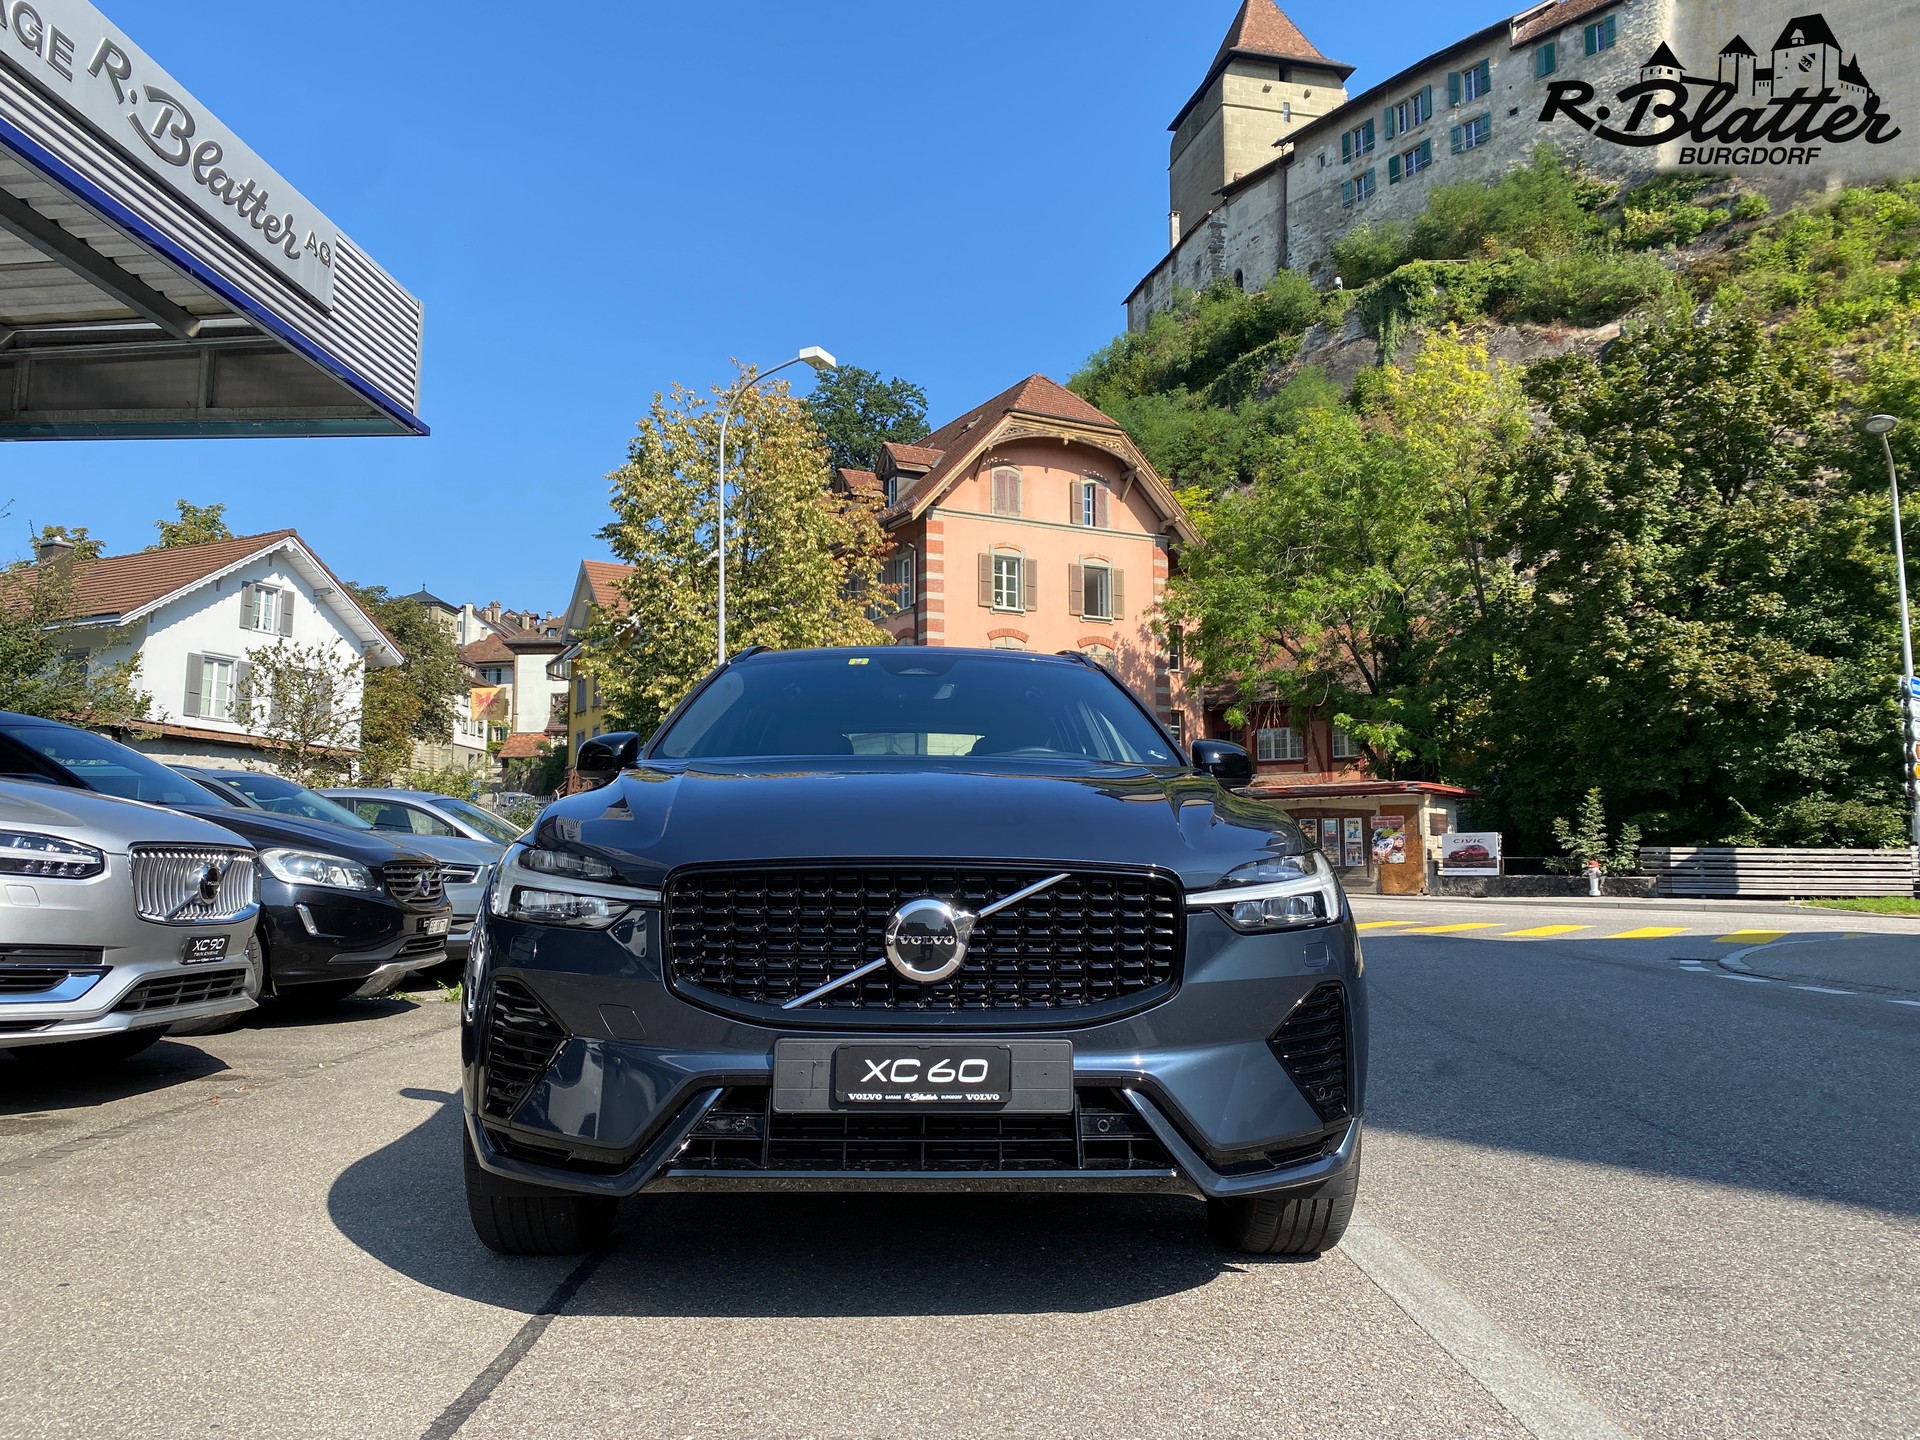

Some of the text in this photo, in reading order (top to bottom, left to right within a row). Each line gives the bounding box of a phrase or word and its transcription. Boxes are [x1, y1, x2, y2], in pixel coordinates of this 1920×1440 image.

[0, 0, 75, 83] GE
[304, 229, 331, 269] AG
[898, 935, 955, 945] VOLVO
[848, 1093, 883, 1101] VOLVO
[965, 1093, 1000, 1101] VOLVO
